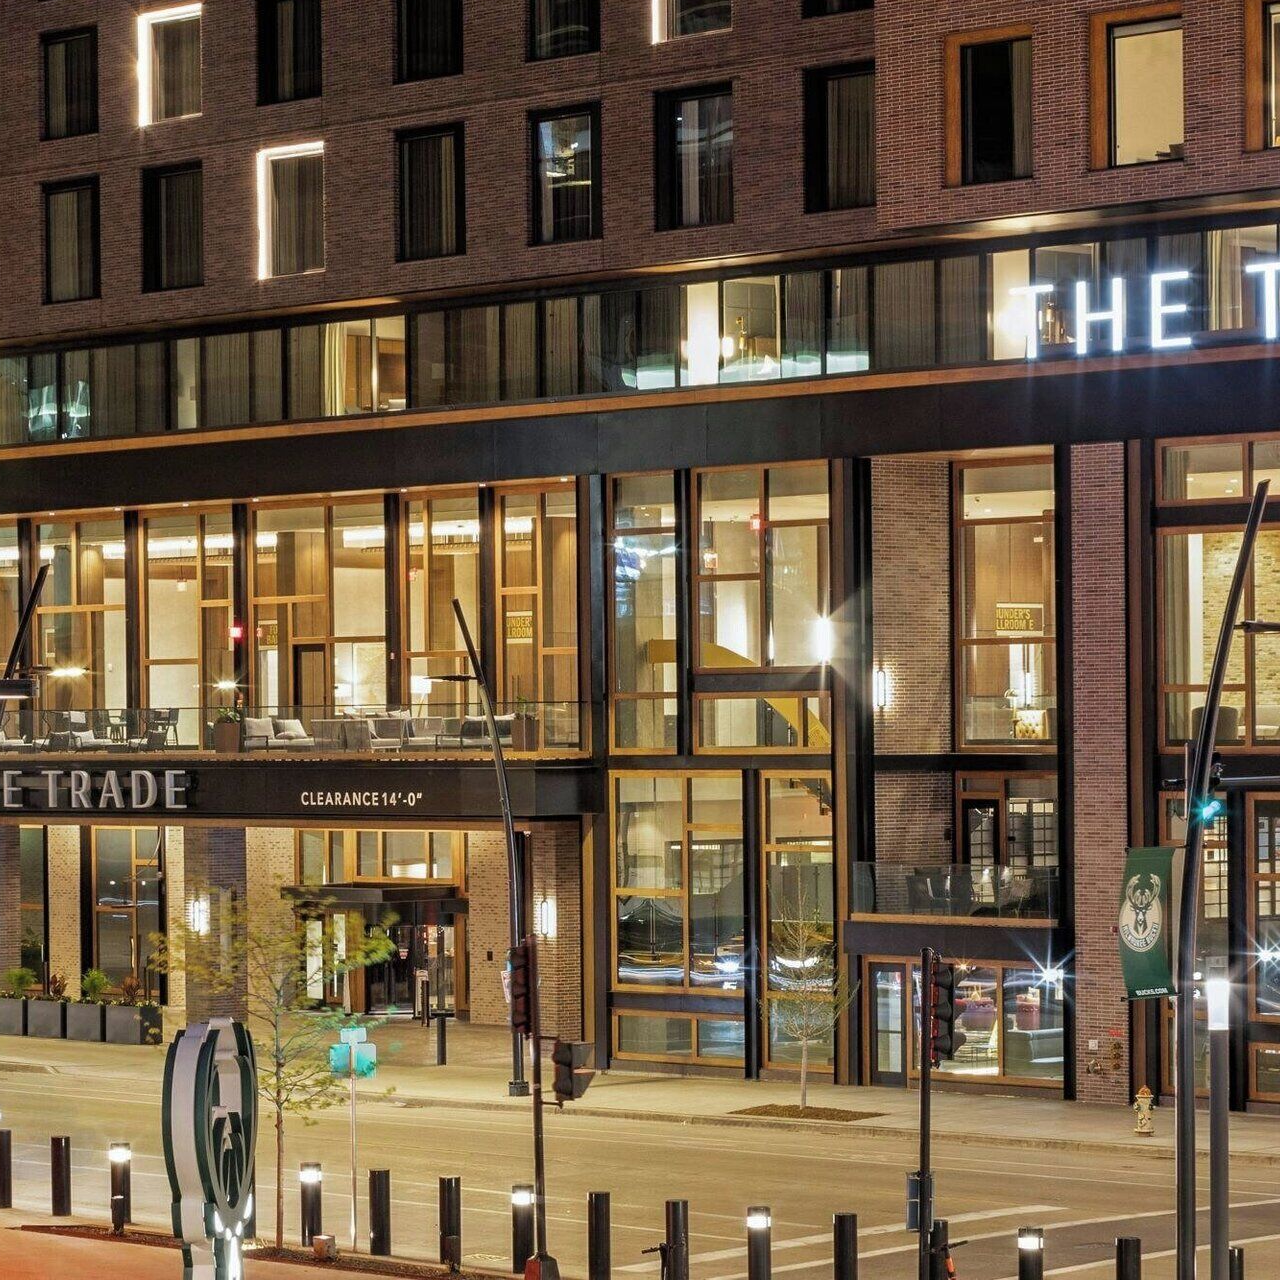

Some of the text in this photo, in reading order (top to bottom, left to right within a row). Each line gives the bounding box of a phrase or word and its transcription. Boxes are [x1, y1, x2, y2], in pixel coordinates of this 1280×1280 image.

[1008, 270, 1193, 359] THE
[40, 770, 188, 809] TRADE
[300, 791, 423, 807] CLEARANCE 14'-0"
